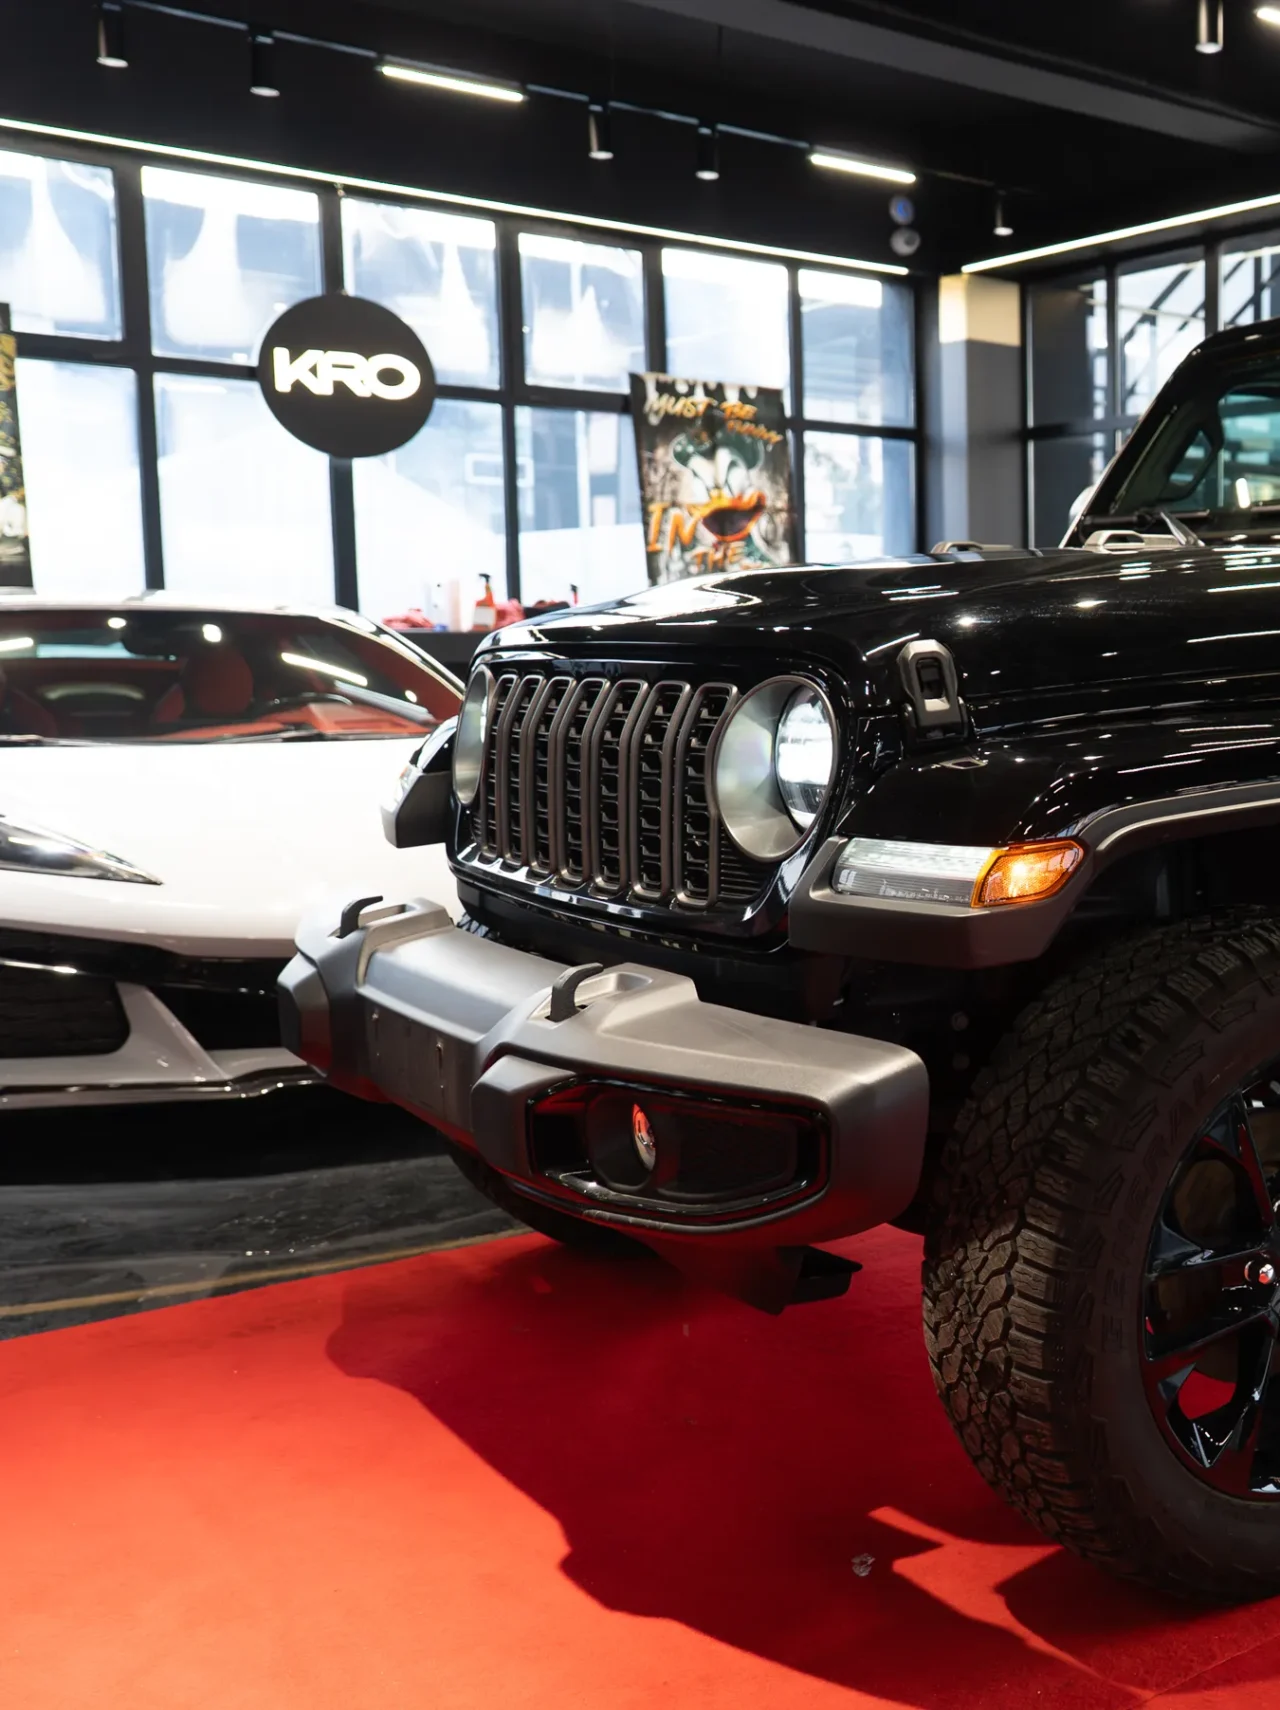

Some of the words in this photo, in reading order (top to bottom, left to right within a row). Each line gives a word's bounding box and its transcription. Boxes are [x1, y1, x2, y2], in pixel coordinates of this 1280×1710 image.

[273, 347, 421, 400] KRO
[644, 394, 718, 420] MUST
[647, 502, 700, 556] IN
[692, 541, 745, 572] THE
